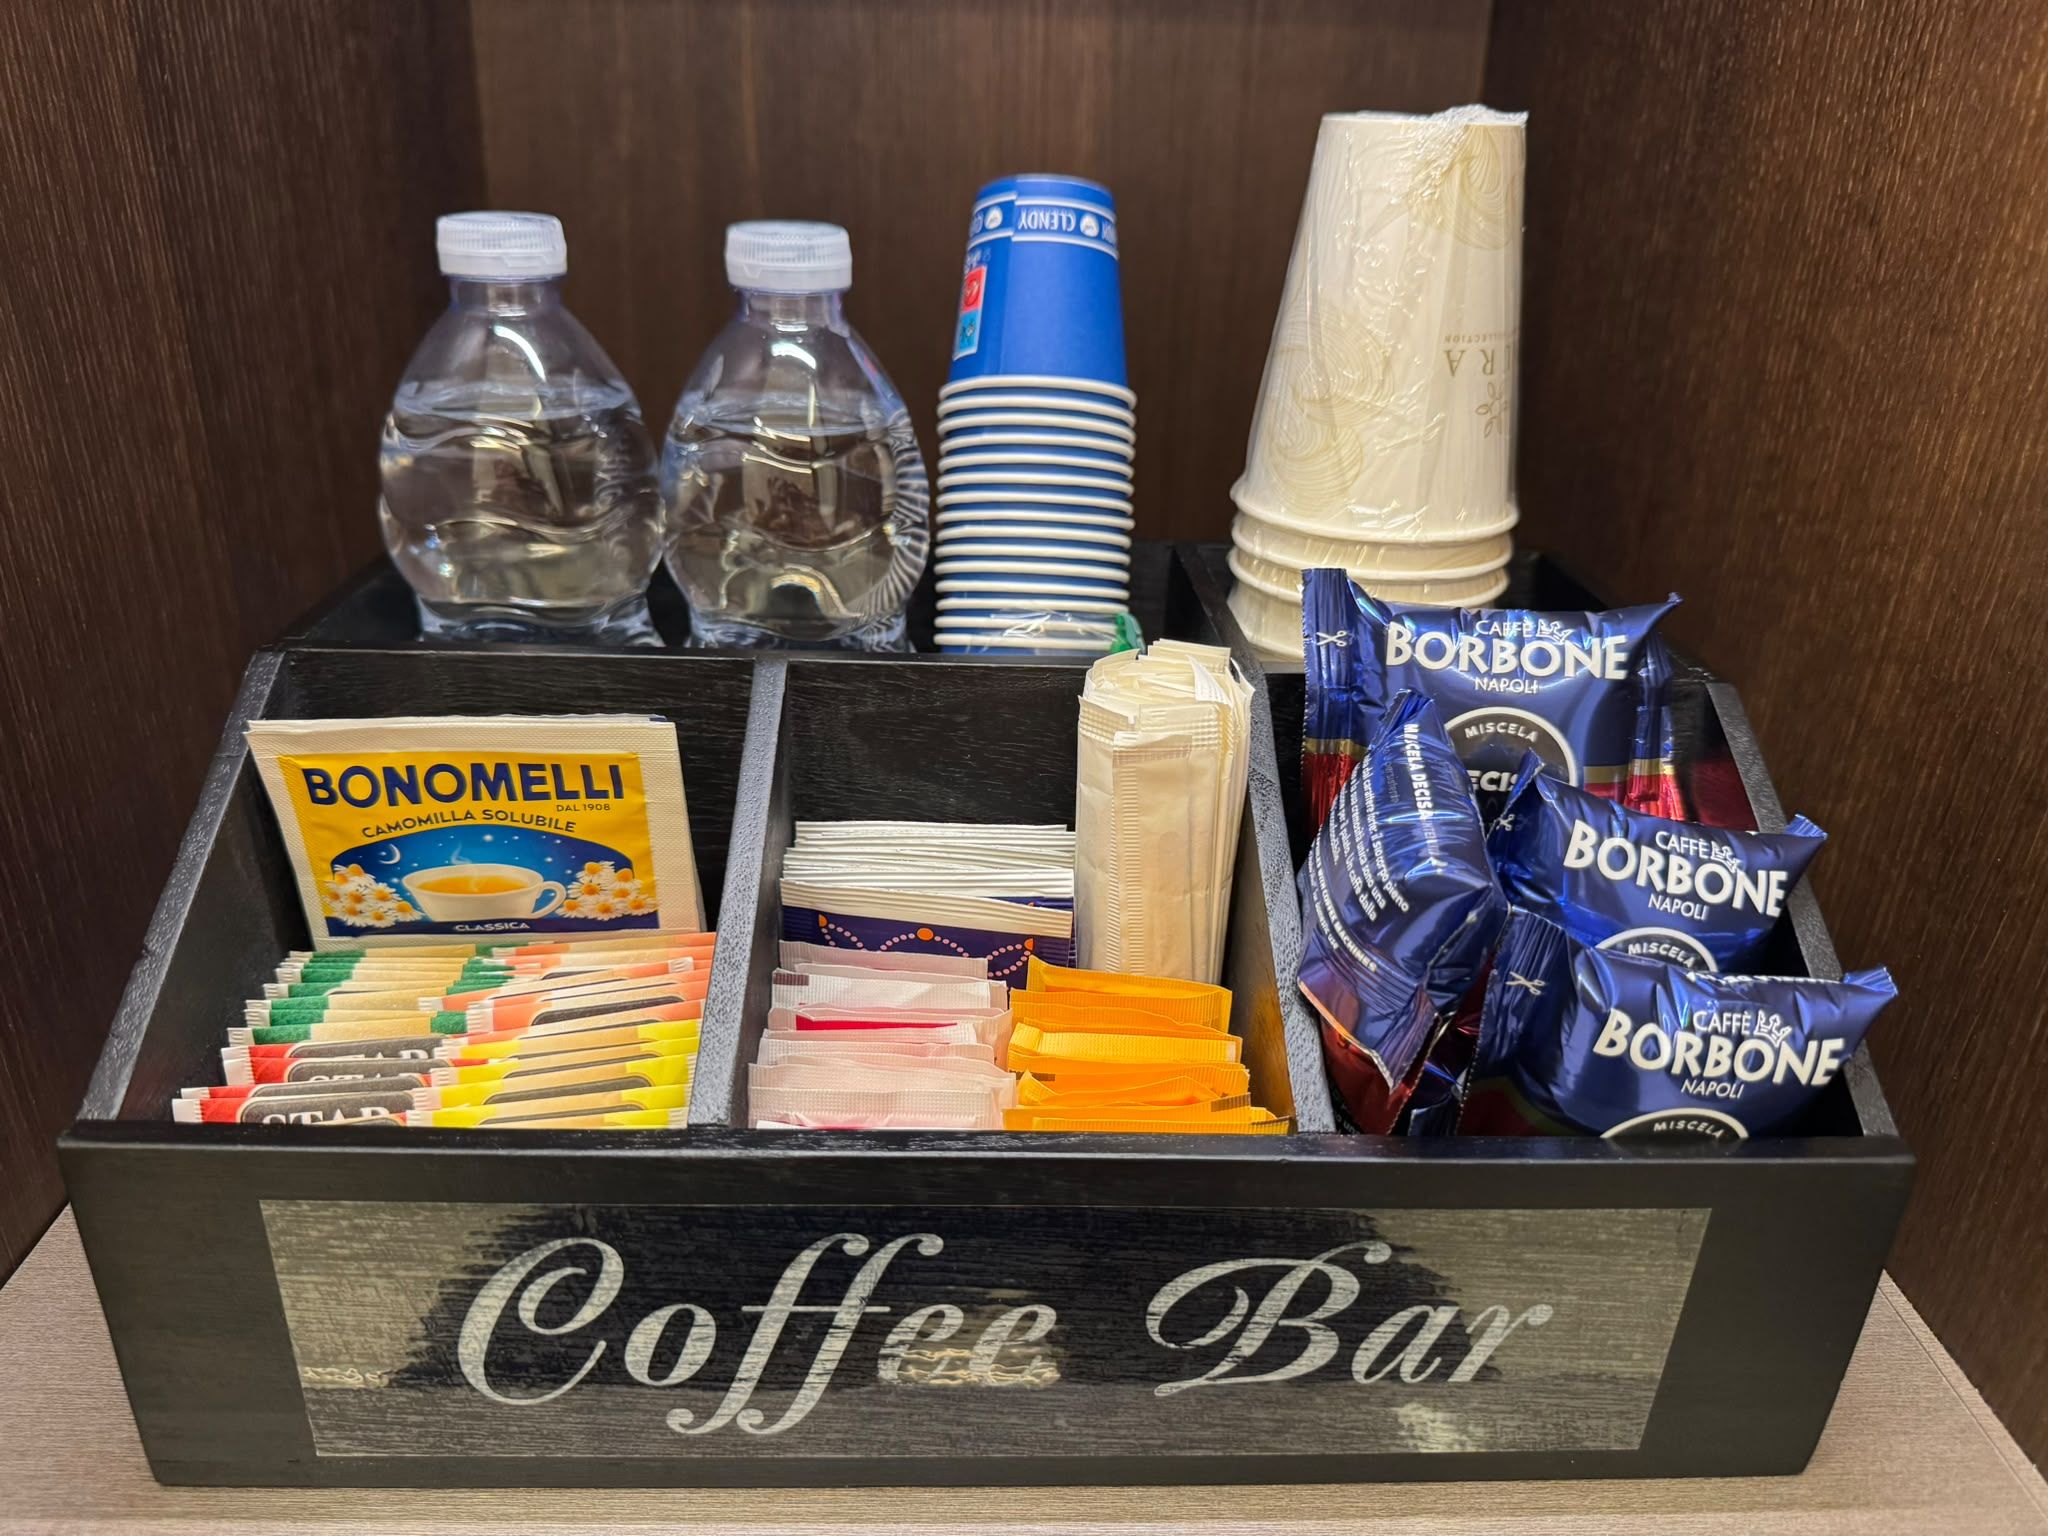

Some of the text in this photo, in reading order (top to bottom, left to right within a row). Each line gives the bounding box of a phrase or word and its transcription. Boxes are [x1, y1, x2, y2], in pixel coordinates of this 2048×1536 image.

[1018, 208, 1076, 232] CLENDY
[1475, 617, 1533, 638] CAFFÈ
[1386, 620, 1629, 680] BORBONE
[1475, 677, 1540, 694] NAPOLI
[1464, 721, 1540, 744] MISCELA
[301, 762, 624, 808] BONOMELLI
[1403, 723, 1434, 820] MISCELA DECISA
[556, 803, 611, 813] DAL 1908
[362, 809, 577, 839] CAMOMILLA SOLUBILE
[1357, 842, 1368, 865] unica
[1363, 779, 1375, 812] carattere
[1375, 856, 1390, 881] corpo
[1383, 881, 1410, 912] pieno
[1655, 829, 1710, 859] CAFFÈ
[1362, 865, 1374, 887] sono
[1563, 819, 1788, 918] BORBONE
[1344, 854, 1353, 870] Un
[1349, 870, 1366, 895] caffè
[1358, 893, 1379, 922] dalla
[1371, 887, 1387, 909] una
[1647, 893, 1709, 921] NAPOLI
[454, 921, 531, 933] CLASSICA
[1334, 920, 1378, 973] MACHINES
[1628, 942, 1696, 970] MISCELA
[1693, 1010, 1752, 1037] CAFFÈ
[1593, 1007, 1844, 1087] BORBONE
[1680, 1079, 1745, 1100] NAPOLI
[1653, 1120, 1726, 1138] MISCELA
[457, 1233, 1554, 1435] Coffee Bar
